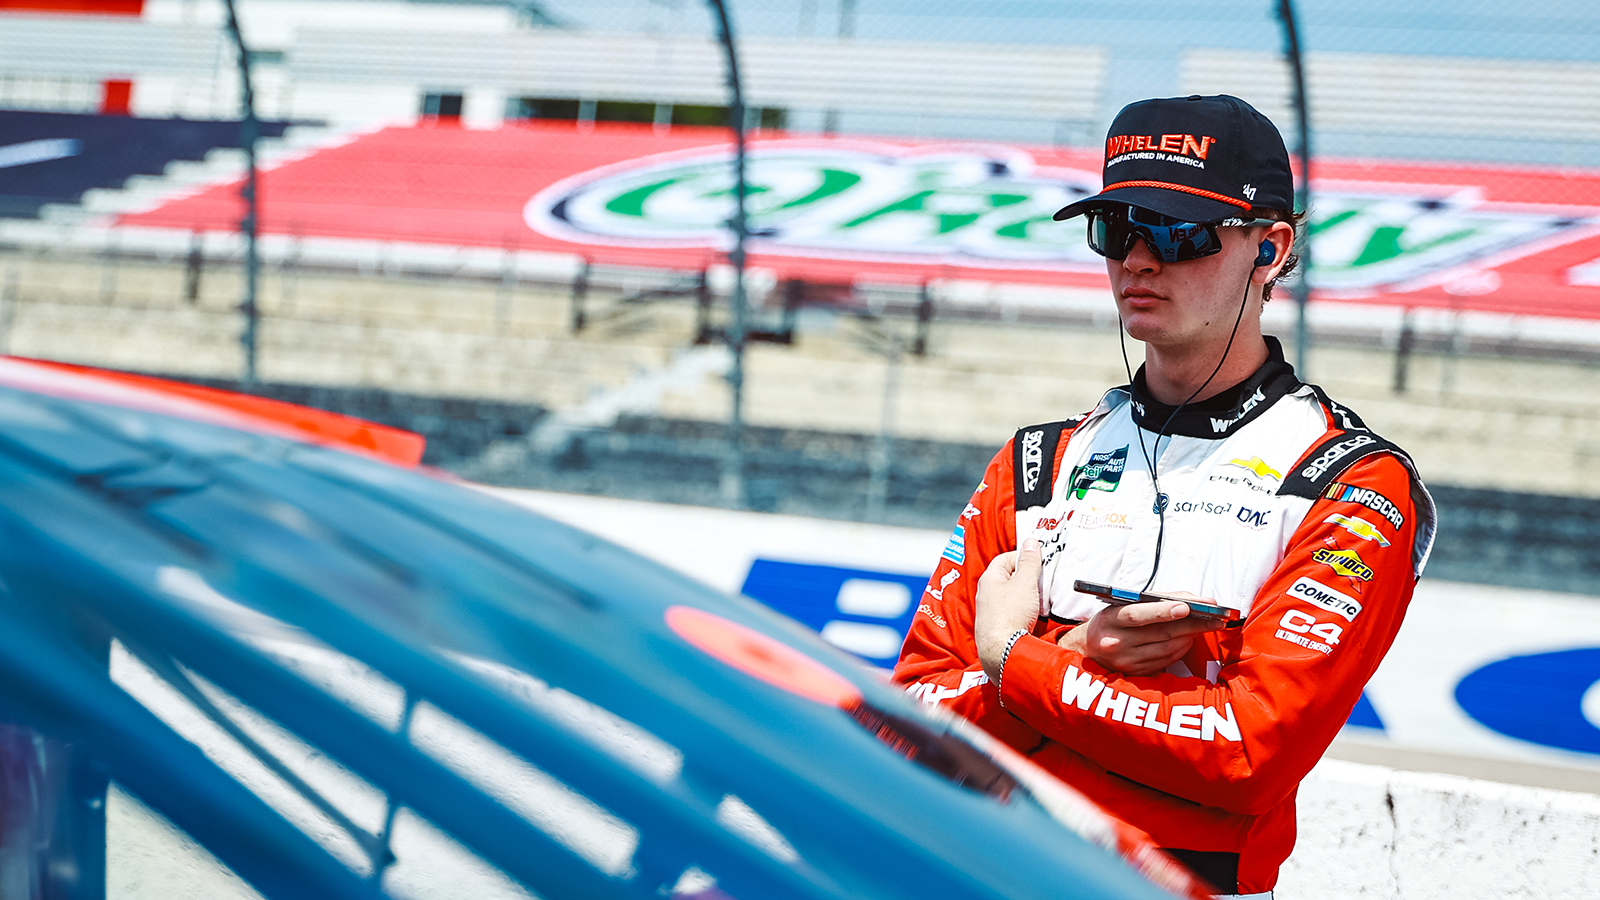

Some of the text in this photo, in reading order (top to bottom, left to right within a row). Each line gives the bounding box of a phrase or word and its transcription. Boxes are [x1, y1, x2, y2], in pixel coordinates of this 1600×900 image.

[1106, 151, 1205, 170] MANUFACTURED IN AMERICA
[1107, 133, 1211, 160] WHELEN
[1021, 430, 1044, 493] sparco
[1301, 435, 1377, 483] sparco
[1349, 487, 1405, 530] NASCAR
[1315, 550, 1371, 580] SUNOCO
[1294, 583, 1357, 616] COMETIC
[1275, 628, 1334, 657] ULTIMATE ENERGY
[1279, 609, 1344, 645] C4
[1061, 664, 1242, 742] WHELEN
